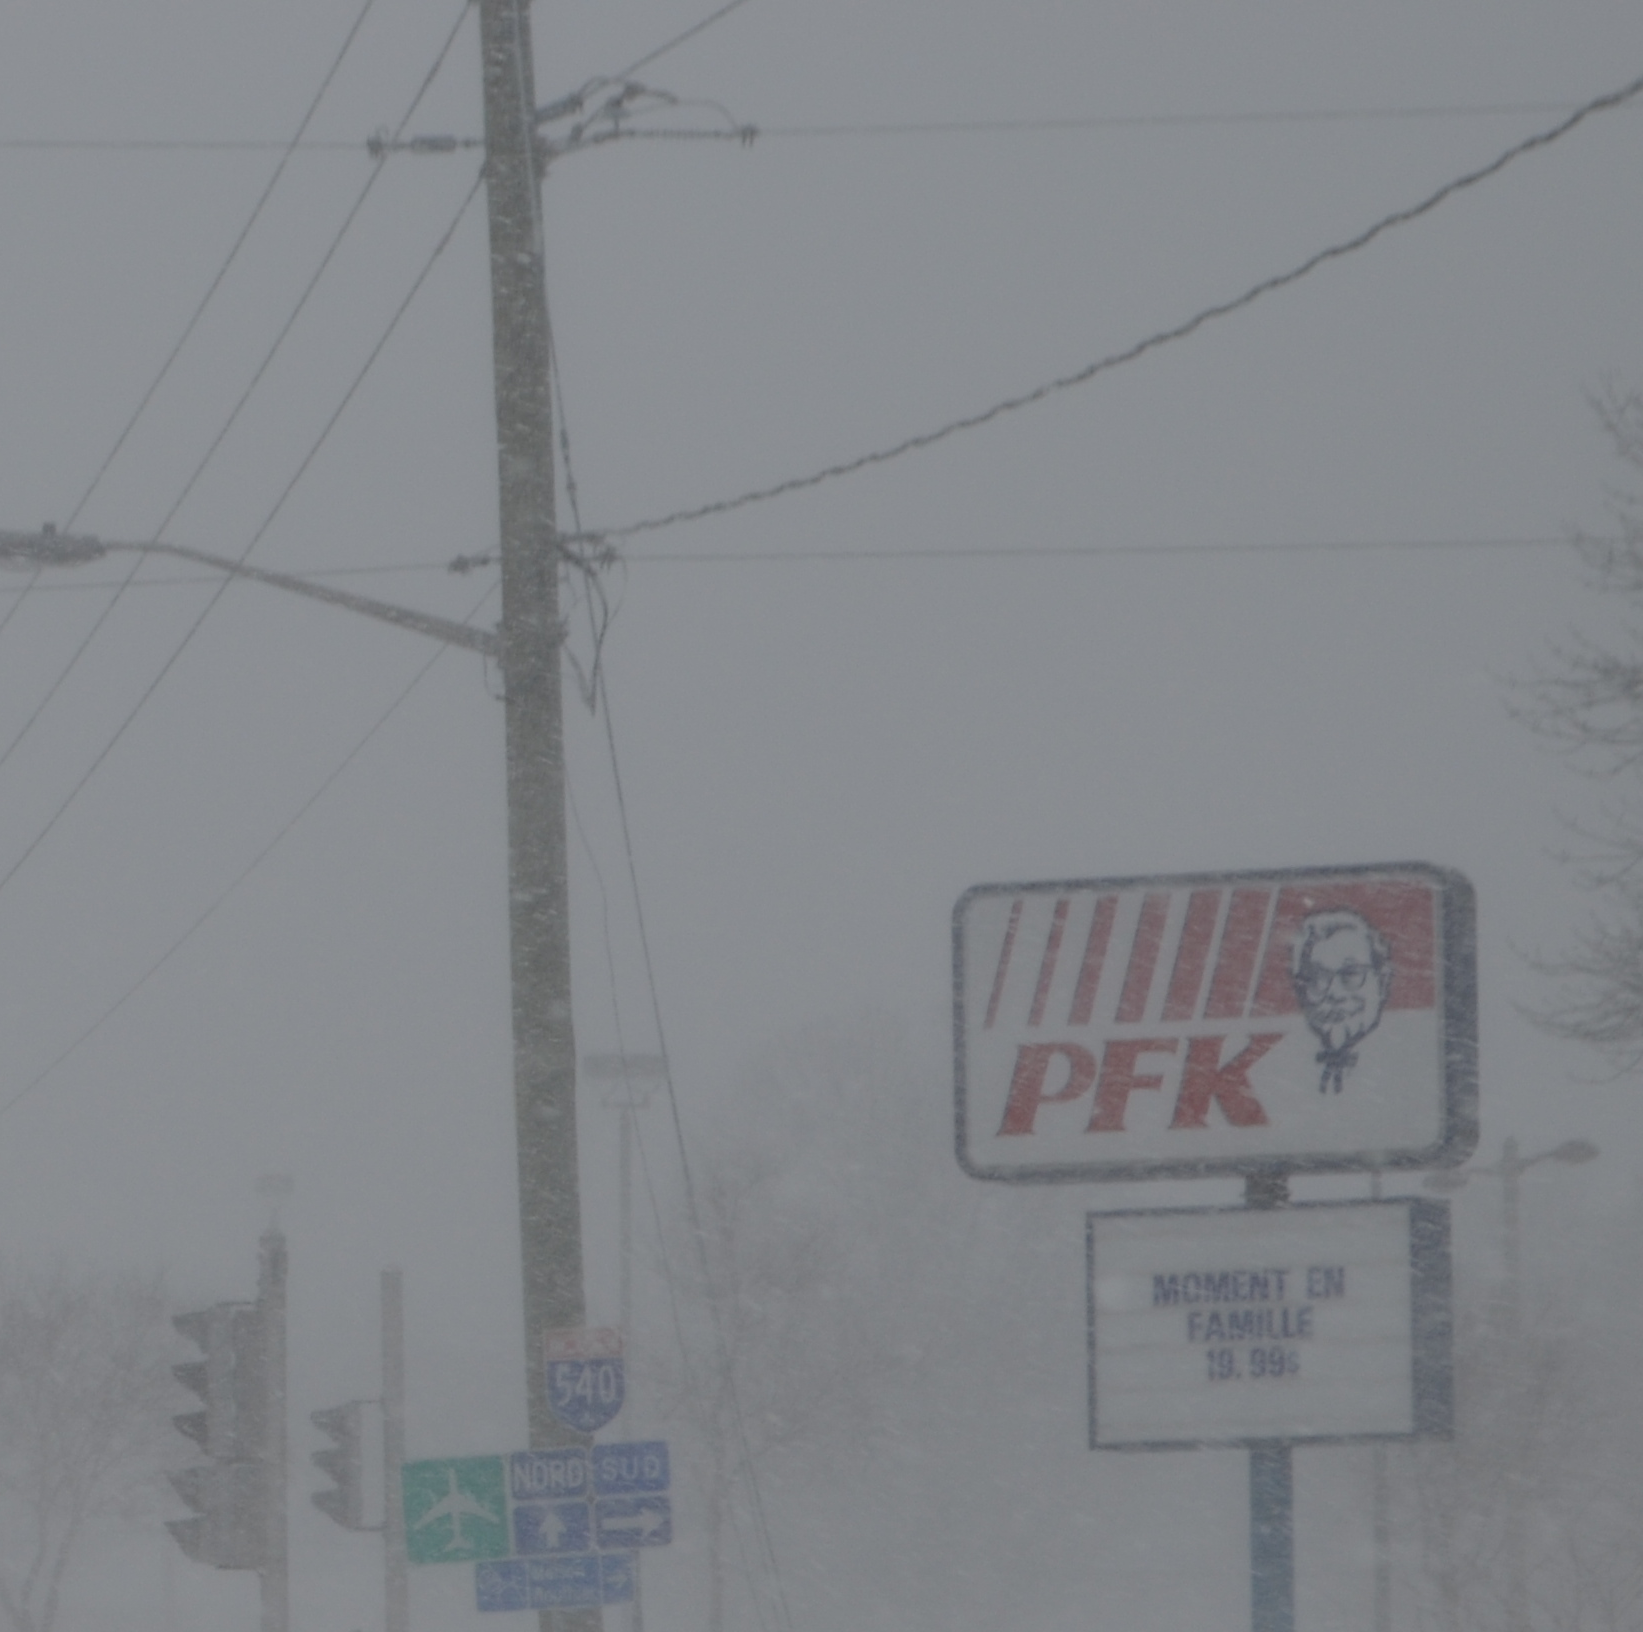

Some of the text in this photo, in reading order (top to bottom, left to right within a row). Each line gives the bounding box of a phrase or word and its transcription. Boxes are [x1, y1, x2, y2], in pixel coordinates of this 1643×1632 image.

[996, 1033, 1285, 1136] PFK
[1152, 1267, 1345, 1304] MOMENT EN
[1187, 1308, 1313, 1342] FAMILLE
[556, 1364, 615, 1406] 540
[515, 1459, 583, 1488] NORD
[601, 1456, 661, 1481] SUD
